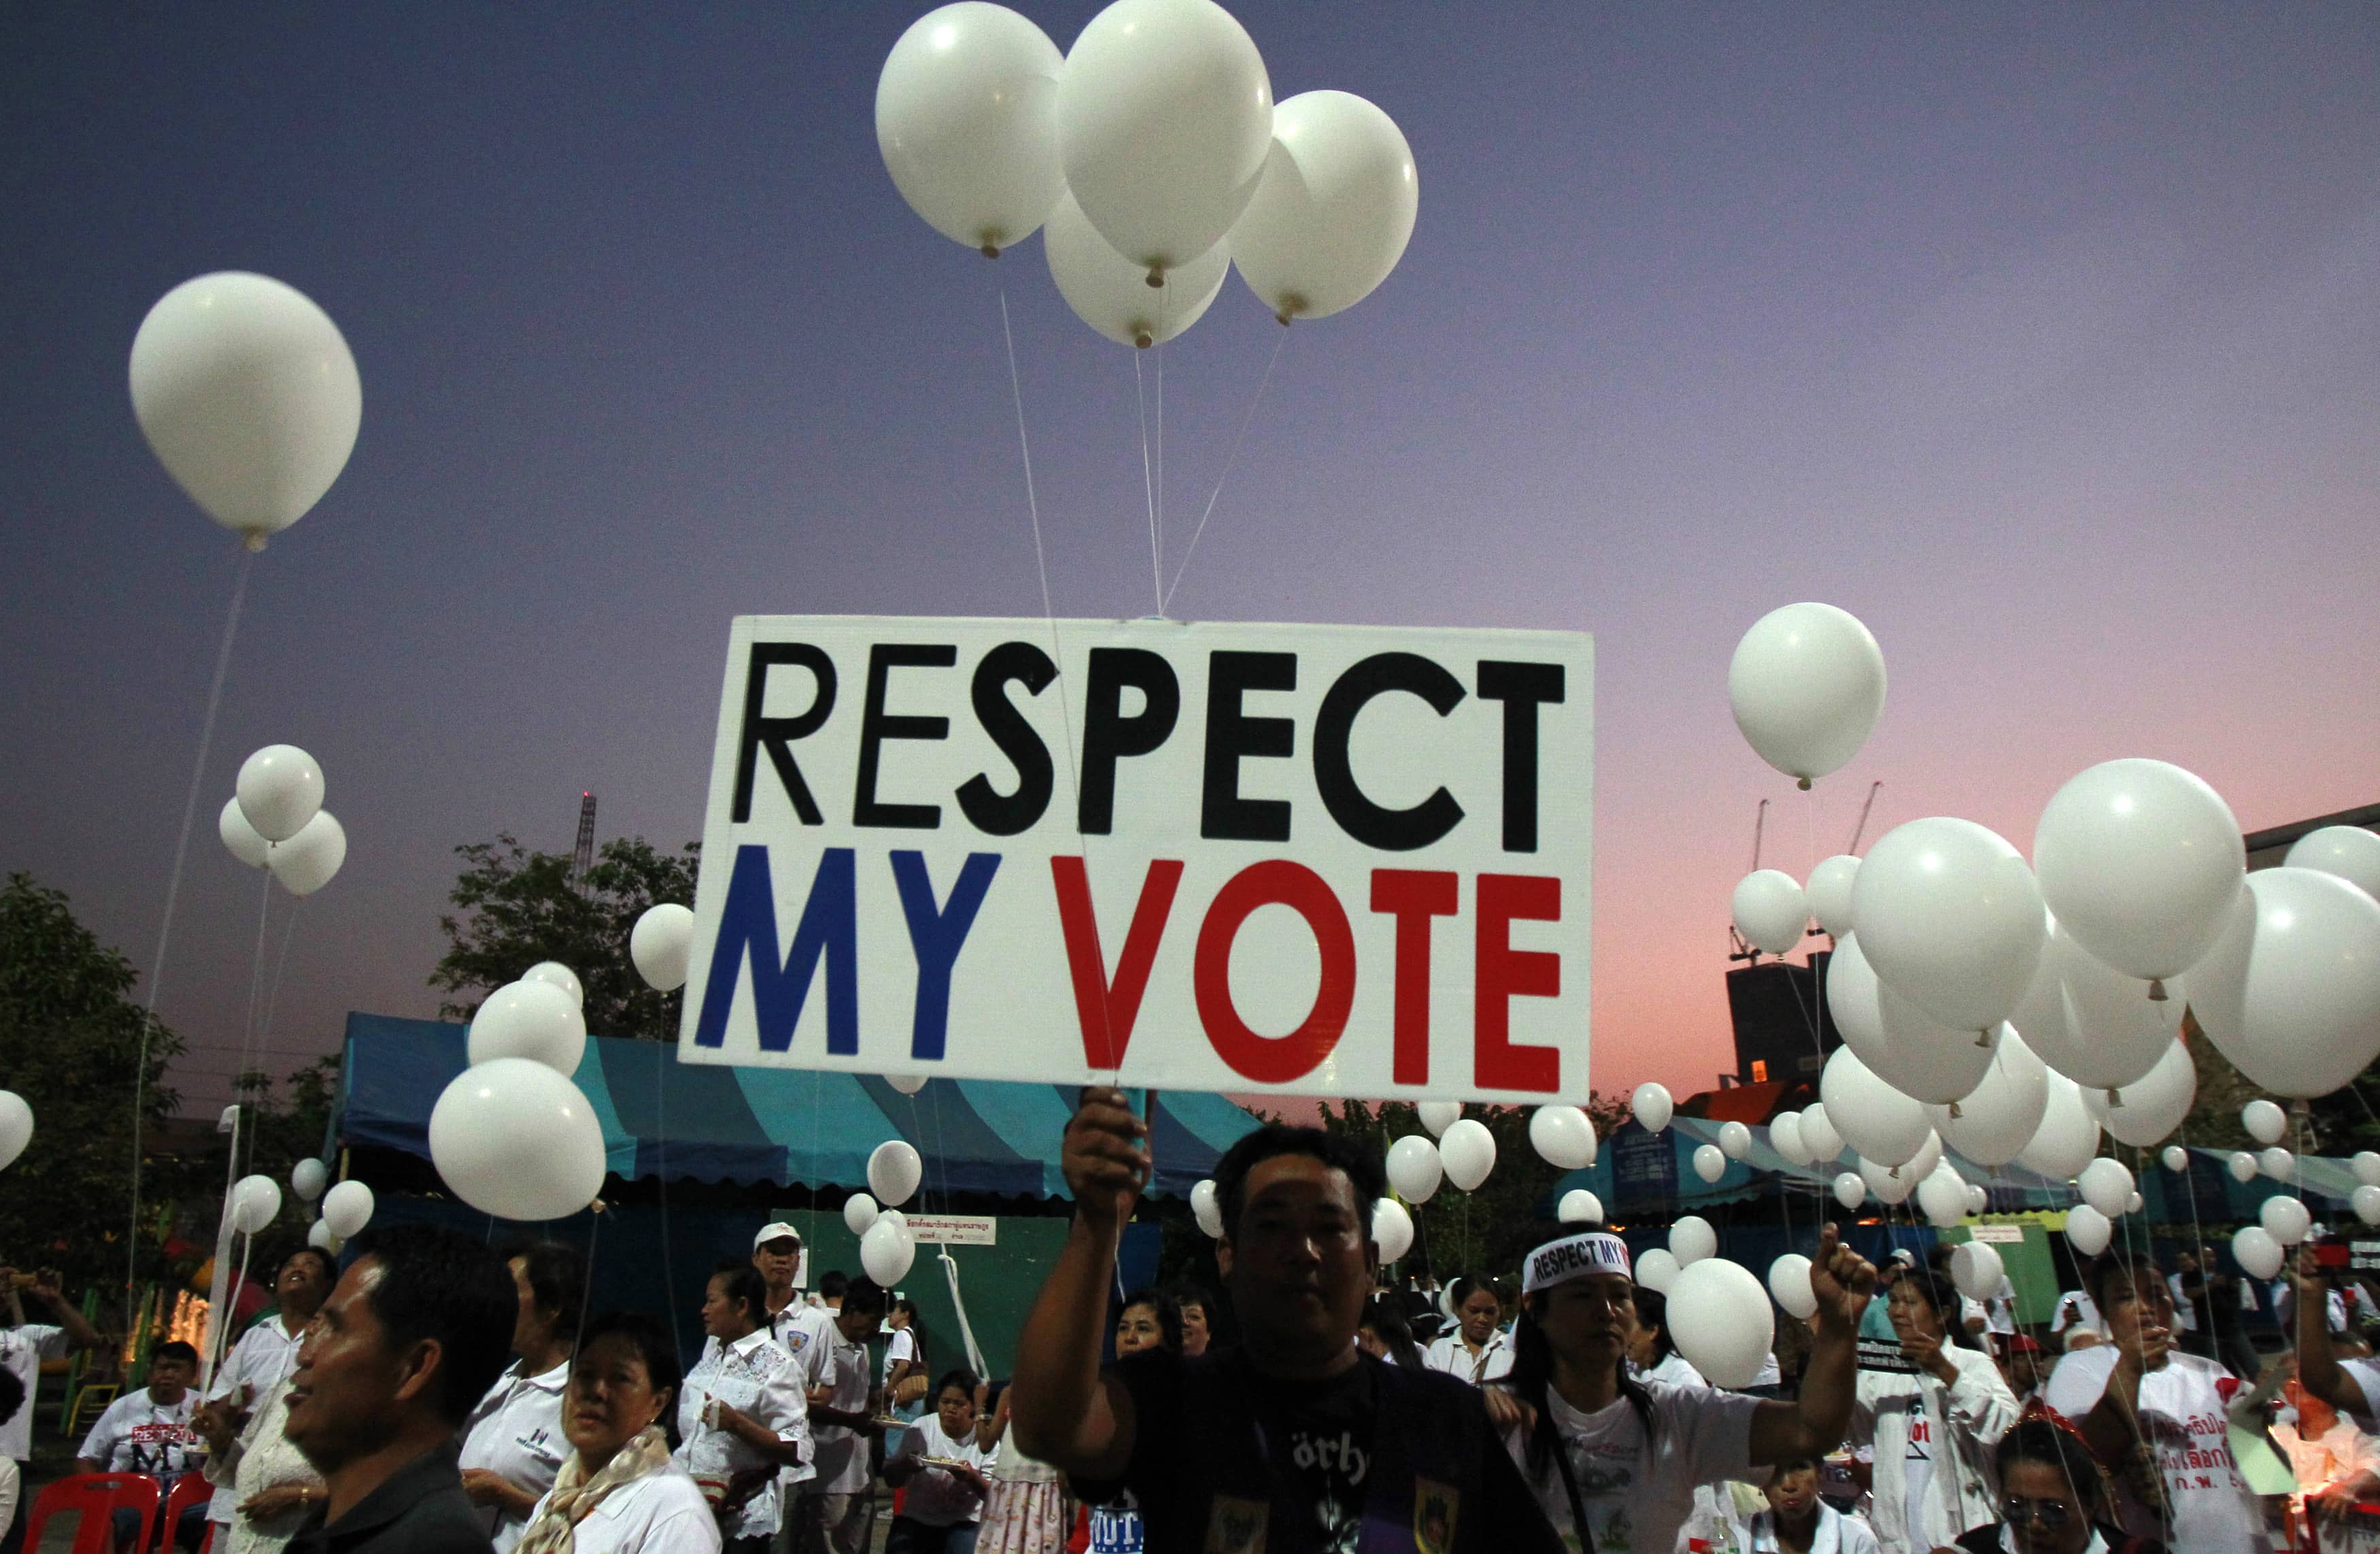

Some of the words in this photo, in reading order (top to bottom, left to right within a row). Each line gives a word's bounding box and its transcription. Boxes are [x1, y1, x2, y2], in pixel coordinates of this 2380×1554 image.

[731, 641, 1565, 854] RESPECT
[694, 845, 1002, 1060] MY
[1050, 856, 1562, 1094] VOTE
[1533, 1240, 1597, 1283] RESPECT
[1599, 1240, 1621, 1264] MY
[1292, 1431, 1369, 1485] örh
[1091, 1511, 1144, 1544] VOT
